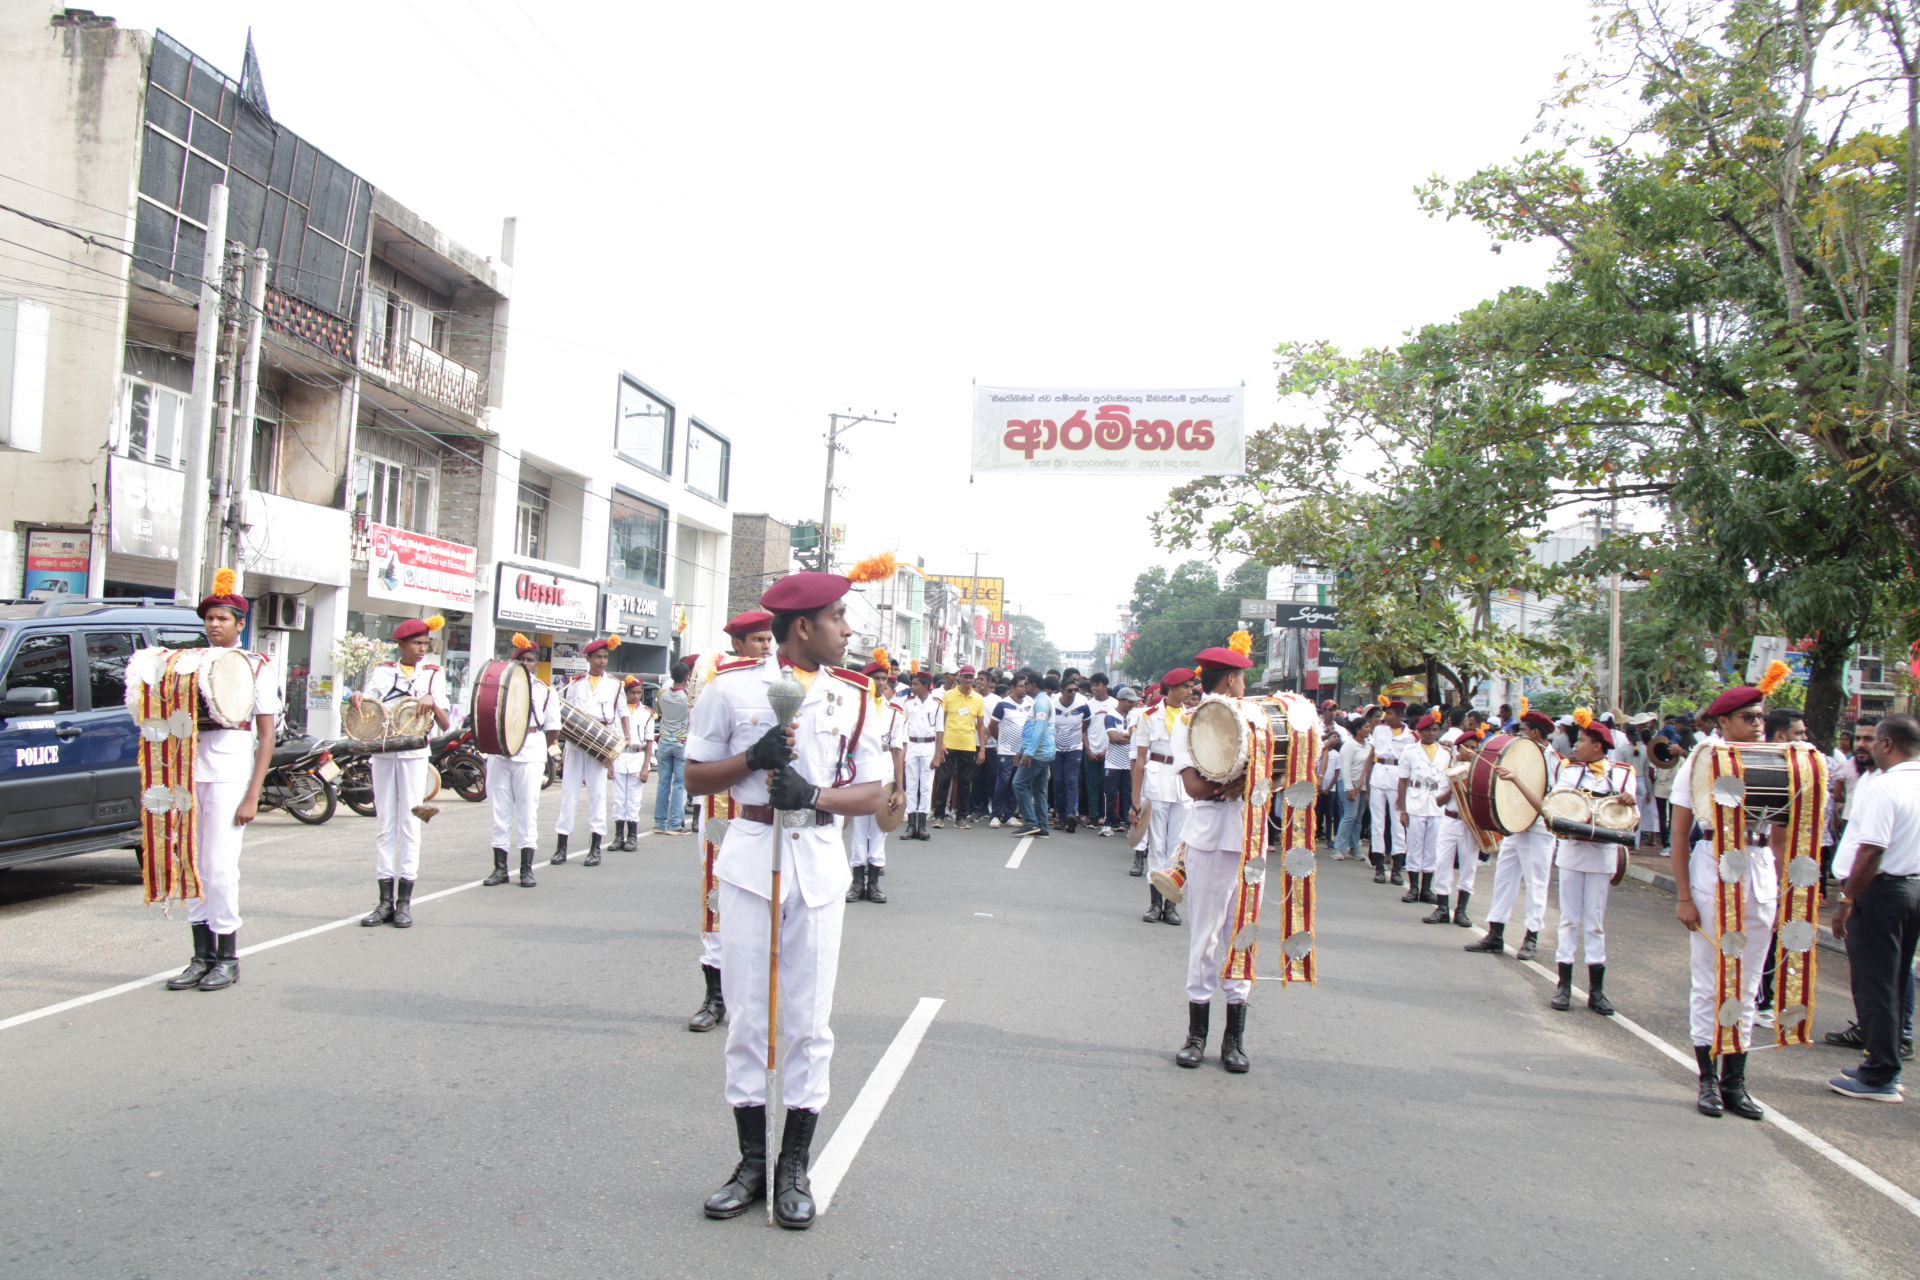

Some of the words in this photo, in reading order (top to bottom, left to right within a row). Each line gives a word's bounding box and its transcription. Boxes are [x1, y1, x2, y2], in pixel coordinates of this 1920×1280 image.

[1003, 404, 1215, 460] ආරම්භය
[516, 574, 566, 607] Classic
[962, 587, 997, 600] LCC
[637, 598, 658, 616] ZONE
[16, 745, 59, 767] POLICE
